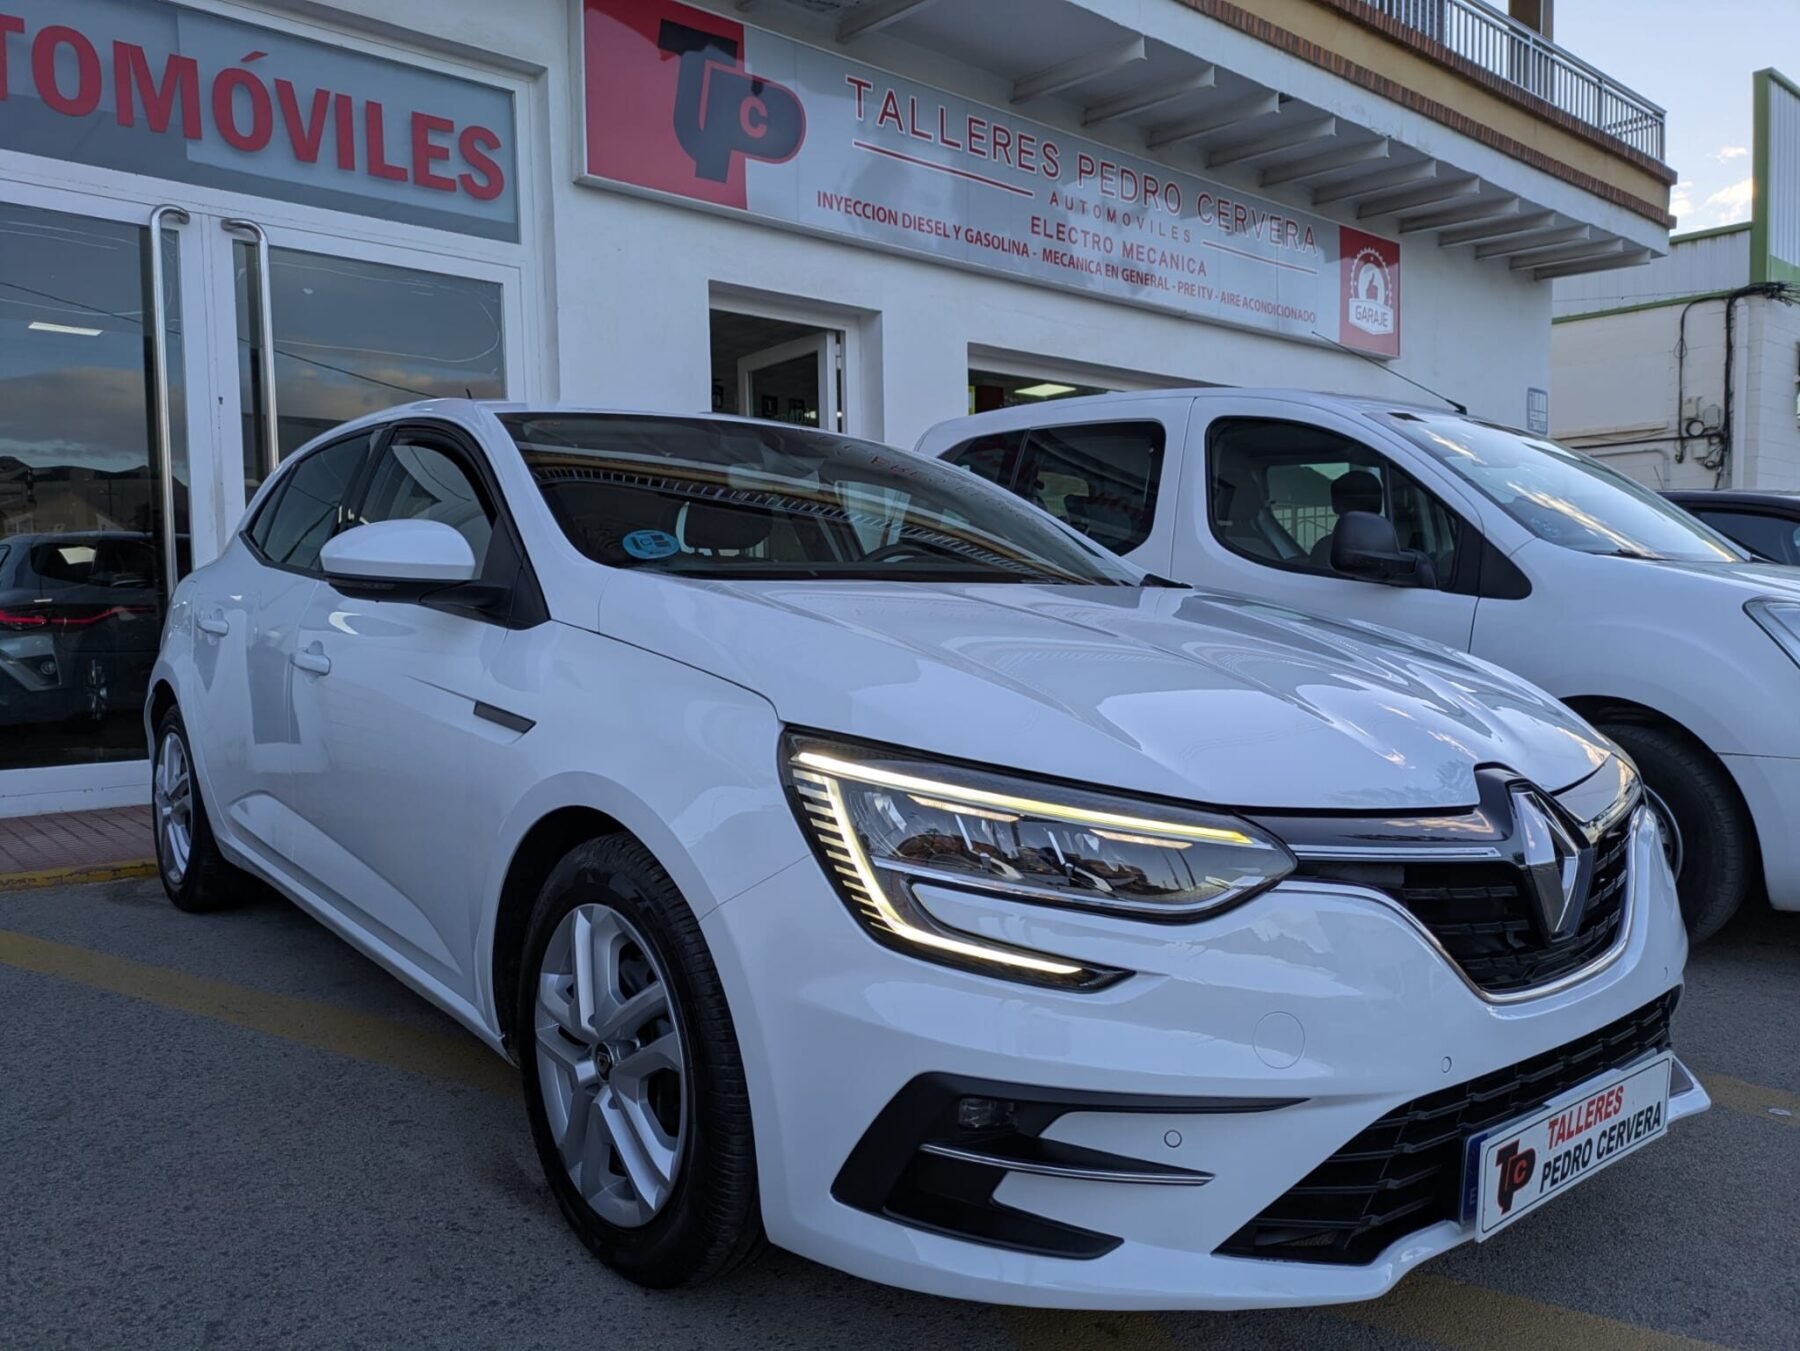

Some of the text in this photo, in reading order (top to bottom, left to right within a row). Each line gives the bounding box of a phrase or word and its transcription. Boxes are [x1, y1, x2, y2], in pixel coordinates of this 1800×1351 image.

[845, 74, 1319, 256] TALLERES PEDRO CERVERA
[1030, 215, 1207, 277] ELECTRO MECANICA
[1049, 191, 1191, 243] AUTOMOVILES
[817, 190, 898, 226] INYECCION
[902, 213, 950, 239] DIESEL
[953, 224, 962, 240] Y
[964, 228, 1030, 258] GASOLINA
[1042, 247, 1102, 277] MECANICA
[1105, 263, 1119, 280] EN
[1121, 269, 1170, 291] GENERAL
[1177, 280, 1196, 296] PRE
[1198, 286, 1214, 301] ITV
[1220, 291, 1241, 308] AIRE
[1242, 296, 1316, 324] ACONDICIONADO
[1355, 305, 1389, 327] GARAJE
[1539, 1101, 1662, 1193] PEDRO CERVERA
[1548, 1085, 1624, 1150] TALLERES
